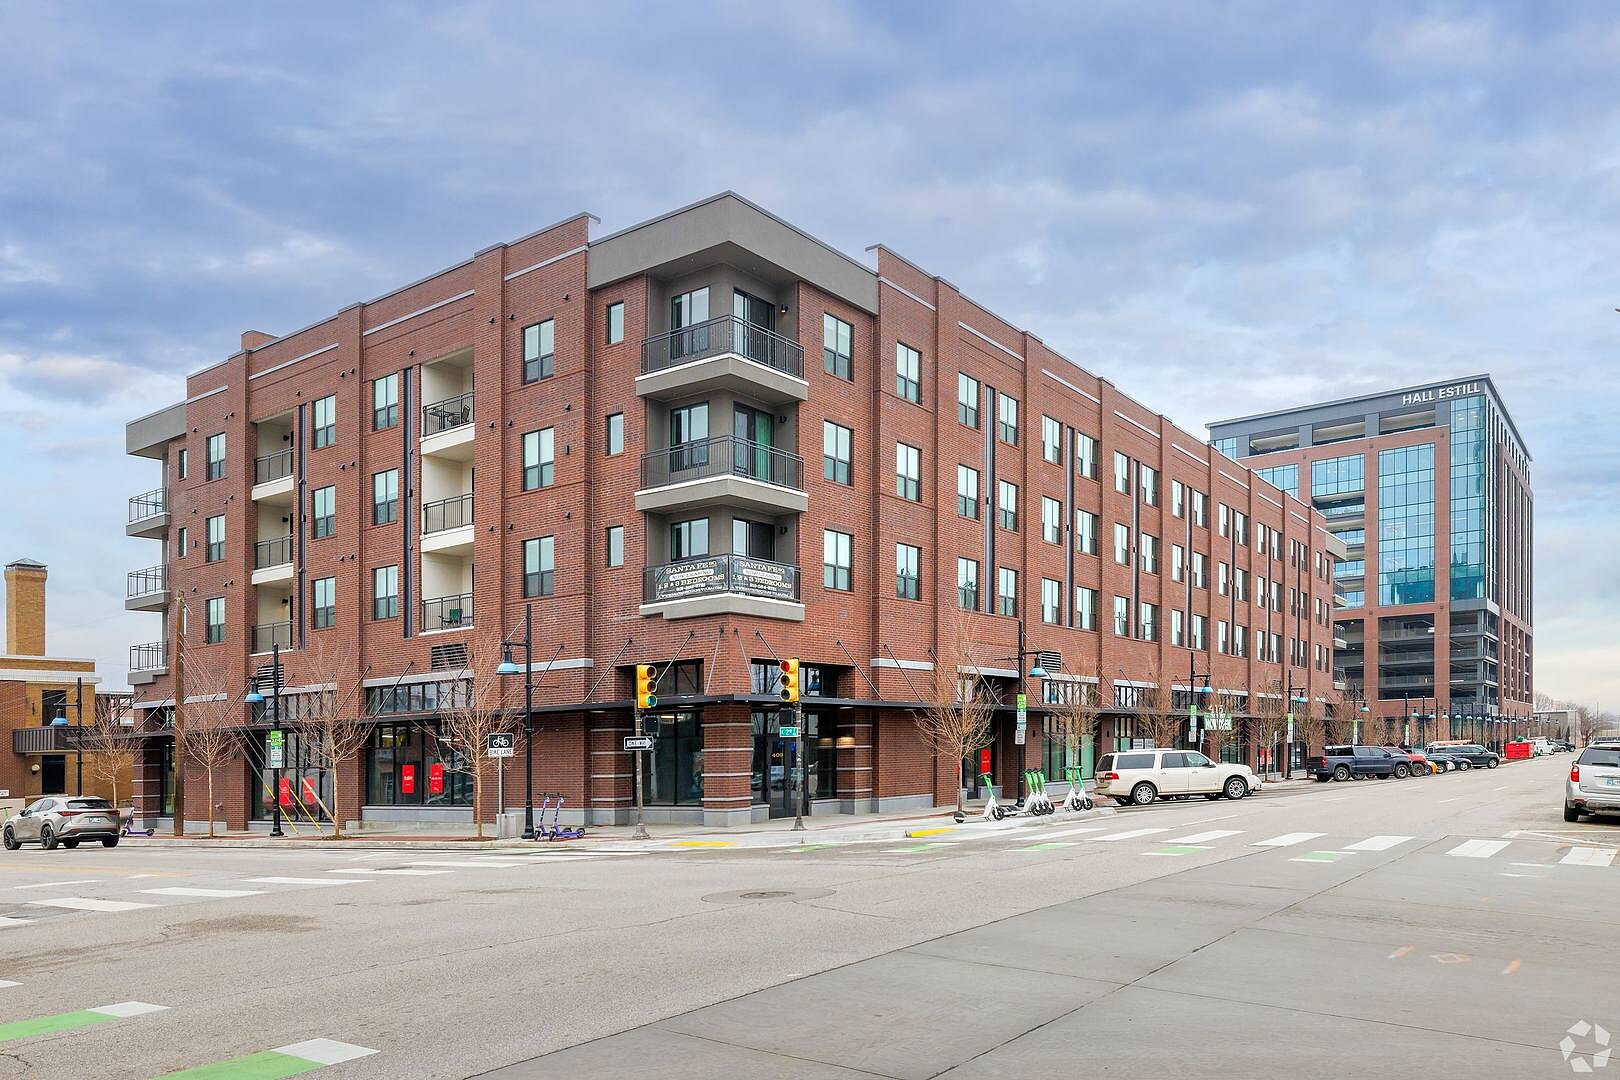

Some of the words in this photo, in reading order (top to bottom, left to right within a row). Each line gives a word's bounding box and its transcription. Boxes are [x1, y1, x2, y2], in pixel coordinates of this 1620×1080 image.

[1402, 390, 1435, 405] HALL
[1438, 382, 1481, 399] ESTILL
[666, 564, 696, 575] SANTA
[696, 562, 708, 570] FE
[739, 561, 767, 571] SANTA
[680, 574, 725, 586] BEDROOMS
[754, 577, 792, 589] BEDROOMS
[1208, 704, 1224, 714] 415
